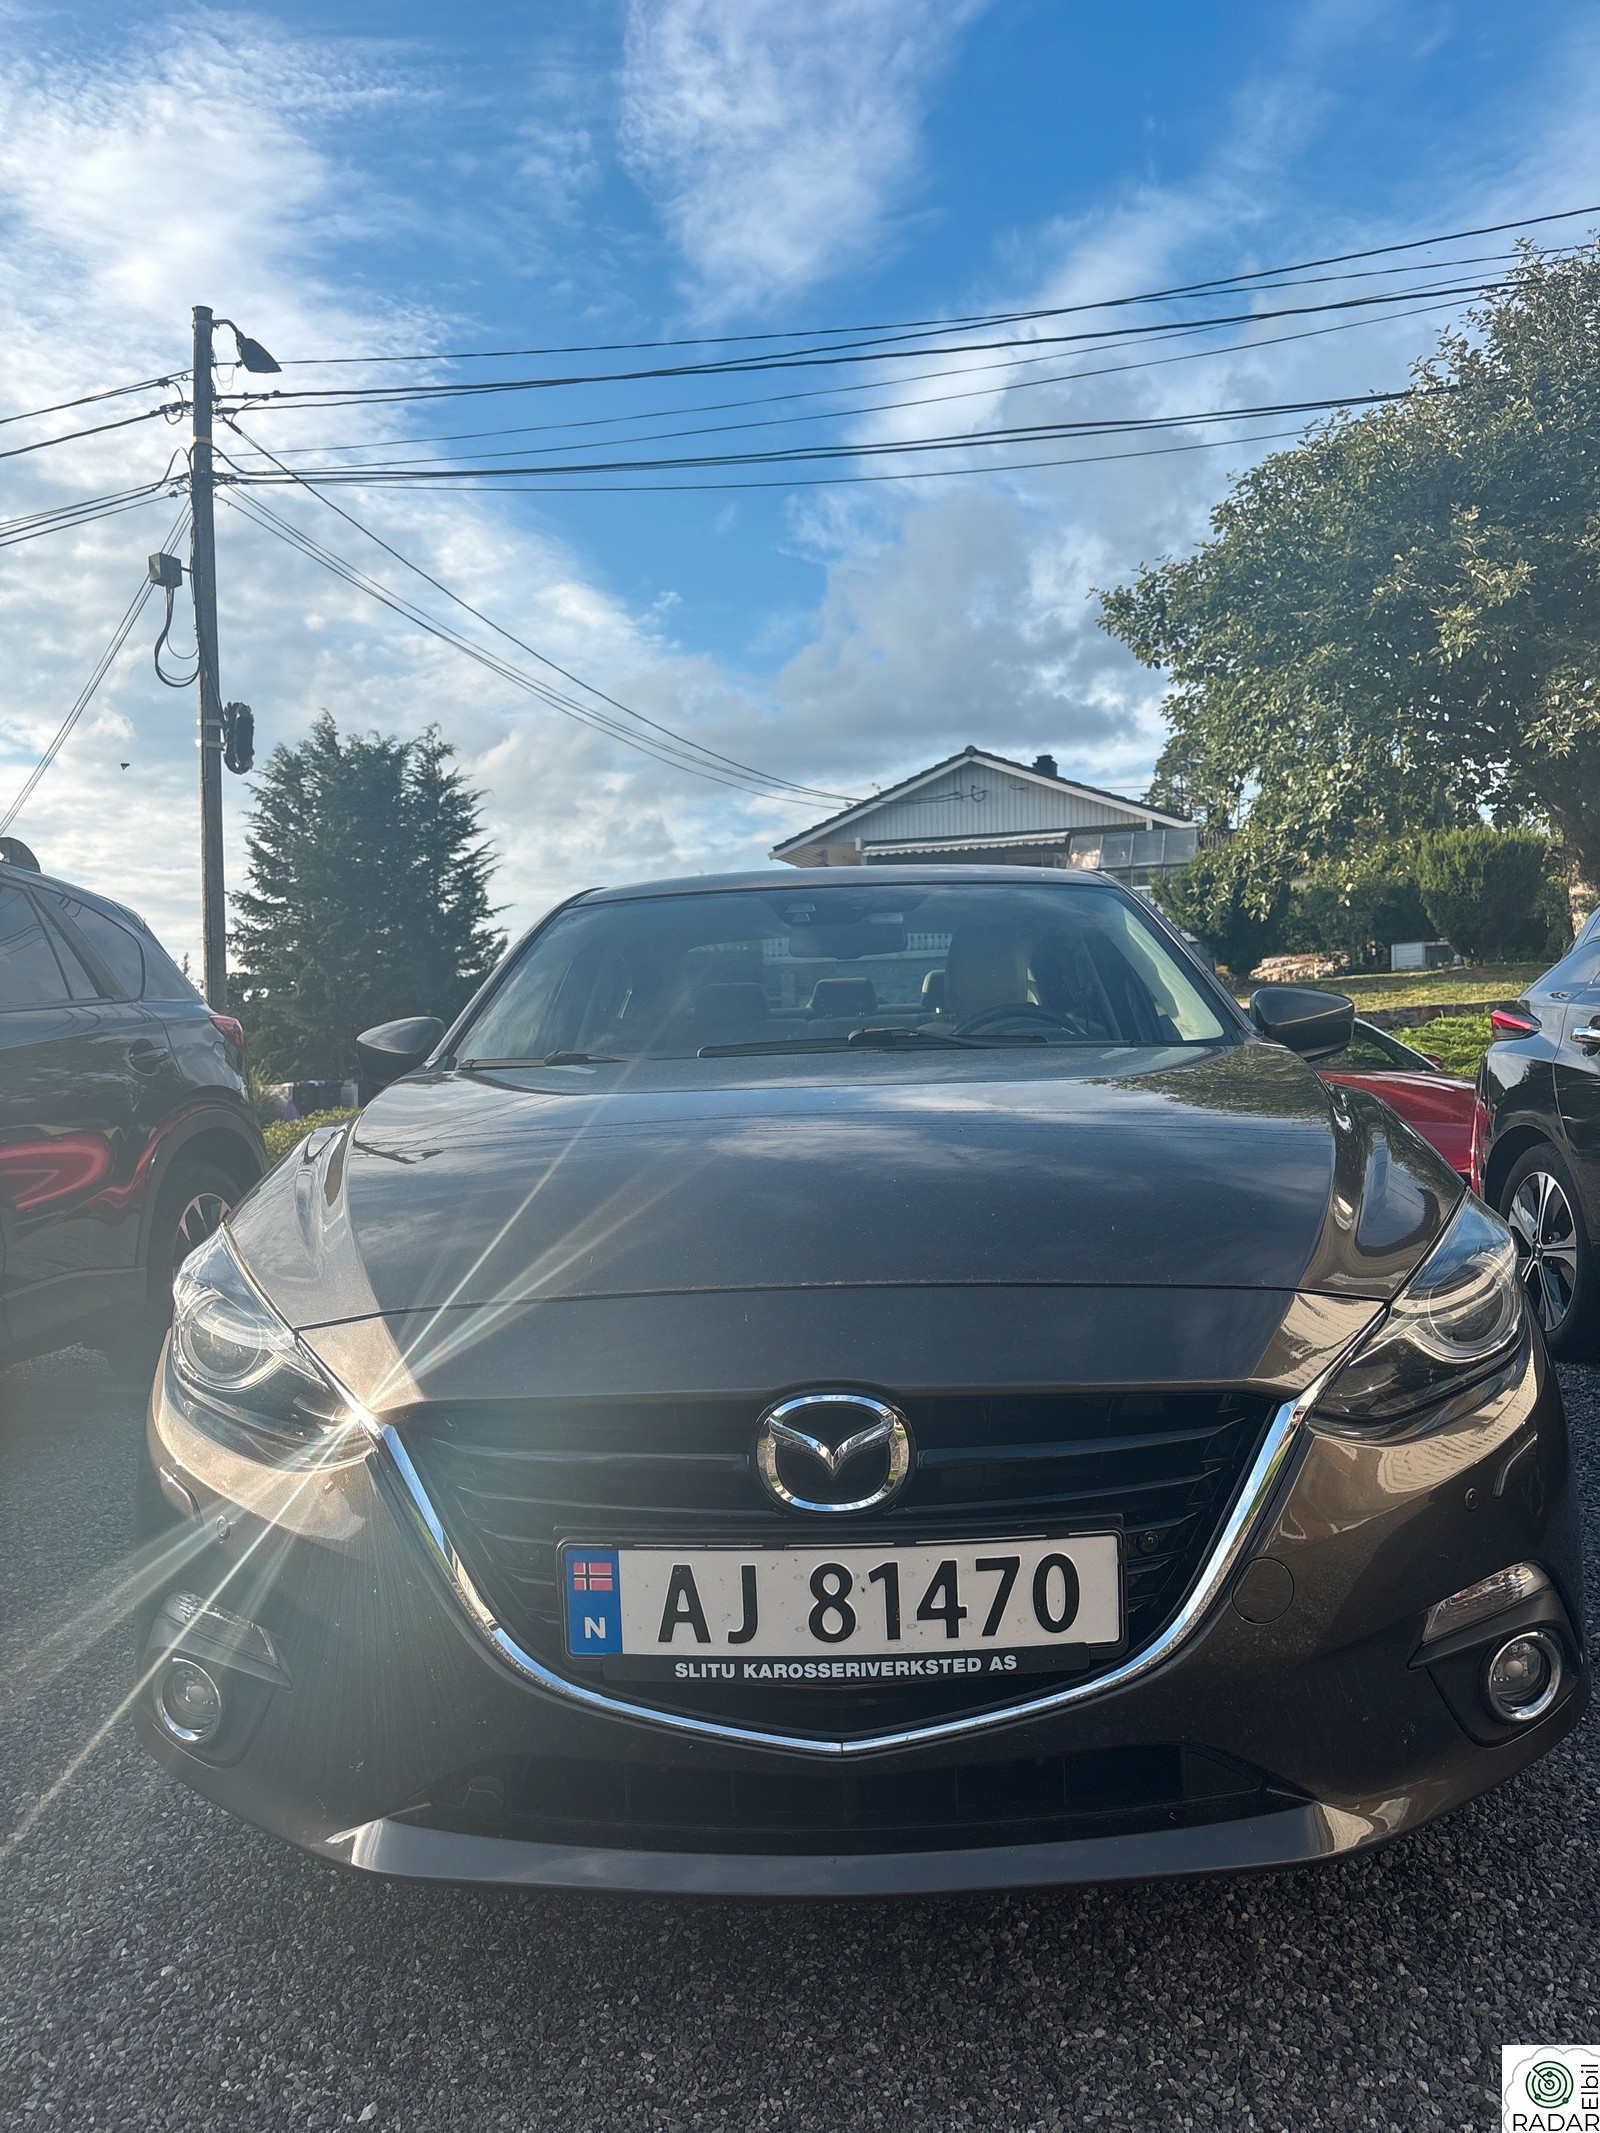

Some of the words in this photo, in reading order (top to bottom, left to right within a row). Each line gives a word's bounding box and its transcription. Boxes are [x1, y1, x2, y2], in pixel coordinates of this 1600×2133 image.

[657, 1564, 757, 1643] AJ
[807, 1553, 1080, 1643] 81470
[584, 1617, 606, 1639] N
[675, 1662, 736, 1679] SLITU
[743, 1658, 982, 1679] KAROSSERIVERKSTED
[989, 1656, 1017, 1671] AS
